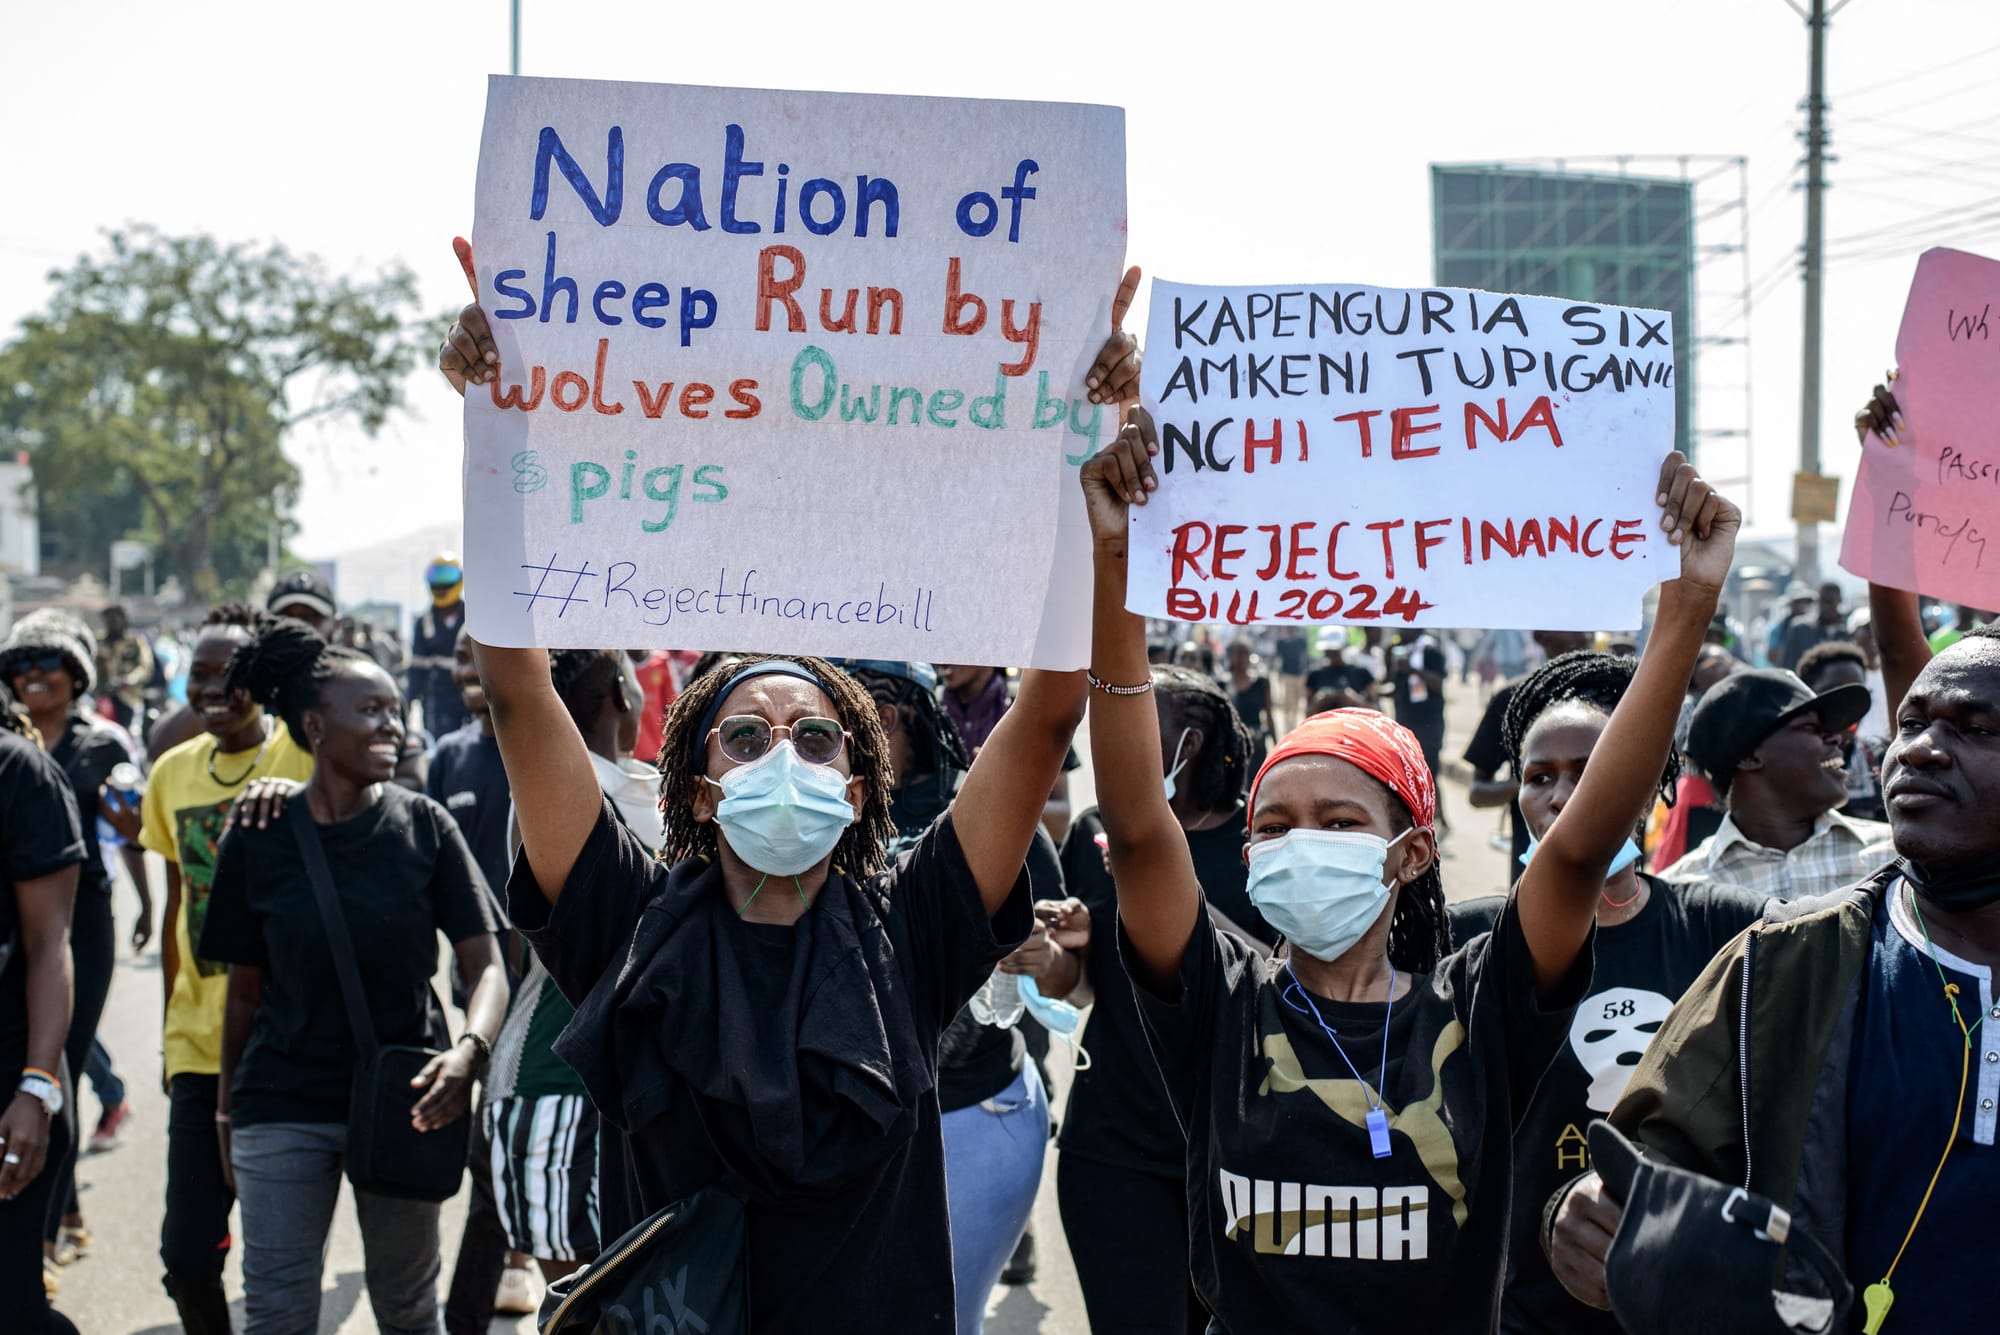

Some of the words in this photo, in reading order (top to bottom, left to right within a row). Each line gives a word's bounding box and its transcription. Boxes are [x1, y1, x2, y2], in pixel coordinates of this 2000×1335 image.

[529, 122, 900, 238] Nation
[955, 158, 1040, 243] of
[492, 231, 719, 347] sheep
[756, 244, 903, 336] Run
[942, 257, 1042, 378] by
[1174, 290, 1529, 350] KAPENGURIA
[1561, 305, 1669, 349] SIX
[489, 338, 763, 420] wolves
[790, 343, 1008, 430] Owned
[1032, 369, 1103, 468] by
[1159, 351, 1370, 404] AMKENI
[1162, 417, 1309, 475] NCHI
[569, 449, 729, 534] pigs
[1274, 583, 1439, 622] 2024
[1602, 999, 1636, 1020] 58
[1219, 1168, 1429, 1261] PUMA
